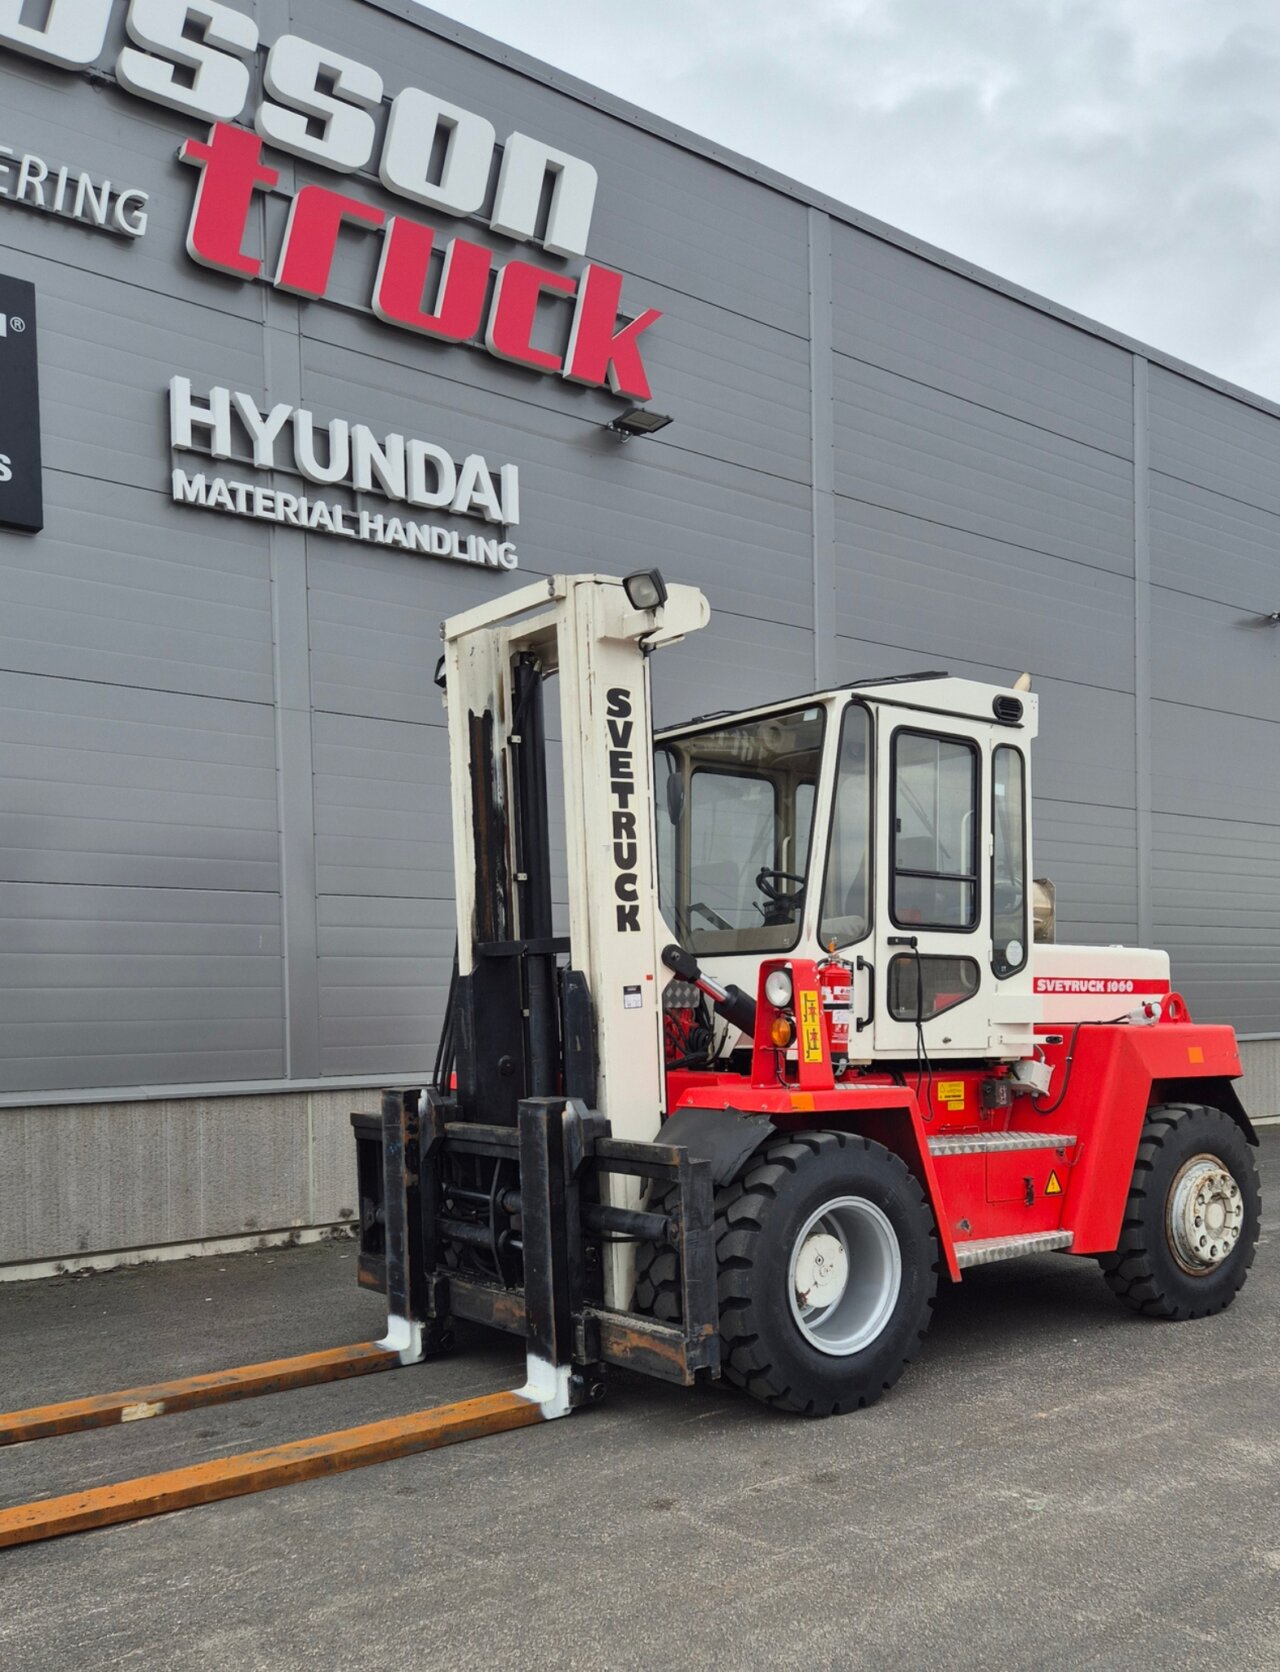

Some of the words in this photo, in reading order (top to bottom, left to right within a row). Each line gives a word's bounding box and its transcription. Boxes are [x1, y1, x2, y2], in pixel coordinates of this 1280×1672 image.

[178, 121, 662, 402] truck
[169, 375, 519, 526] HYUNDAI
[172, 468, 355, 536] MATERIAL
[359, 510, 519, 571] HANDLING
[606, 687, 641, 932] SVETRUCK
[1037, 979, 1105, 992] SVETRUCK
[1106, 980, 1134, 993] 1060
